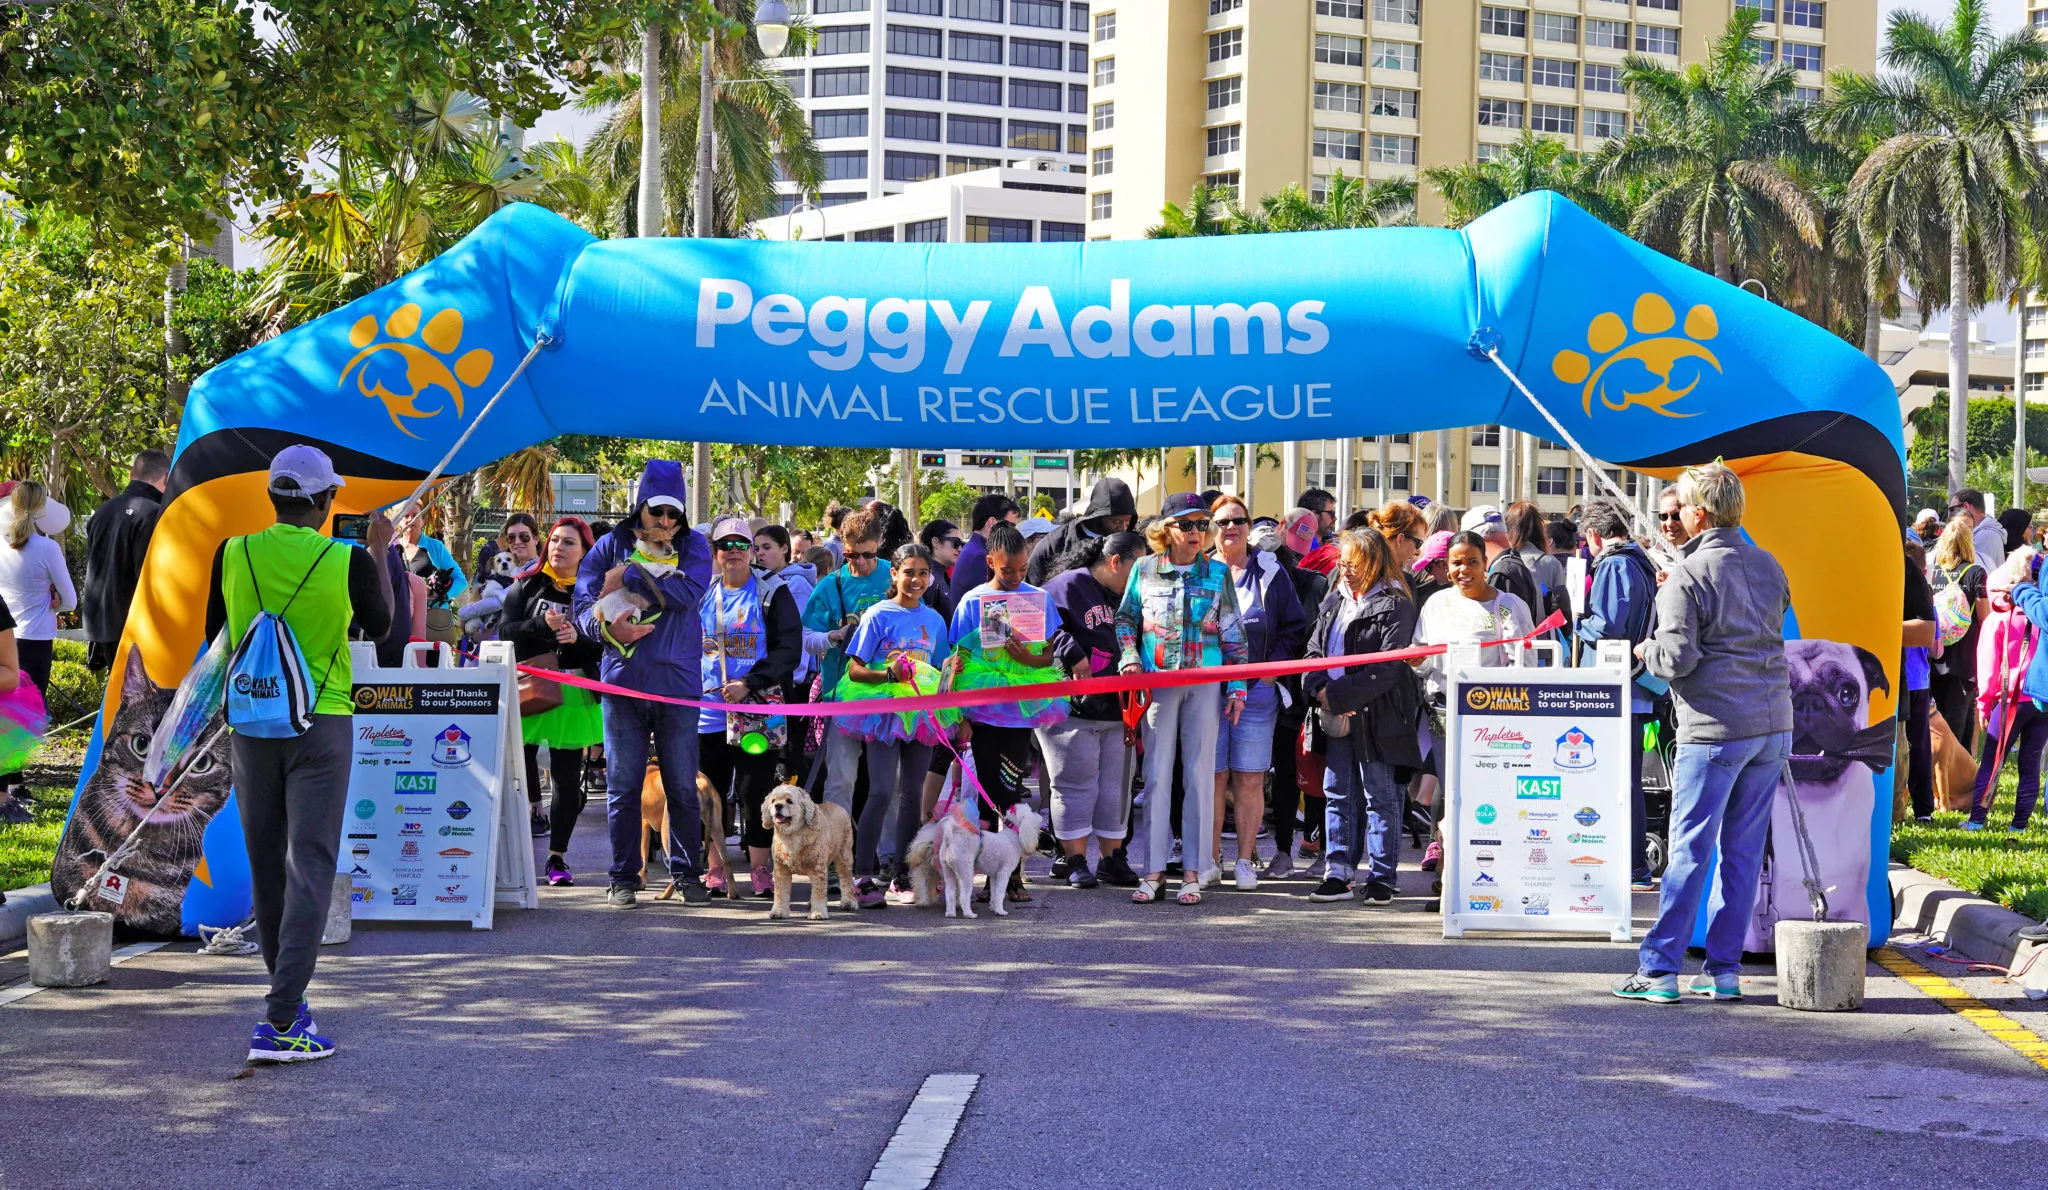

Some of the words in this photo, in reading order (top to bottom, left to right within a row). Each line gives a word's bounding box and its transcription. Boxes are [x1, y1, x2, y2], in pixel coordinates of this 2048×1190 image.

[695, 277, 992, 375] Peggy
[998, 278, 1330, 359] Adams
[699, 378, 902, 422] ANIMAL
[919, 386, 1111, 424] RESCUE
[1131, 382, 1332, 423] LEAGUE
[376, 686, 414, 700] WALK
[421, 689, 454, 698] Special
[456, 689, 488, 697] Thanks
[1490, 686, 1529, 700] WALK
[1538, 690, 1573, 699] Special
[1574, 690, 1610, 700] Thanks
[376, 701, 414, 710] ANIMALS
[421, 699, 431, 707] to
[450, 699, 492, 708] Sponsors
[1490, 702, 1531, 711] ANIMALS
[1538, 700, 1549, 708] to
[1569, 701, 1615, 710] Sponsors
[359, 724, 405, 744] Napleton
[1474, 726, 1524, 747] Napleton
[358, 758, 379, 767] Jeep
[1475, 760, 1498, 769] Jeep
[395, 776, 436, 790] KAST
[1517, 780, 1560, 795] KAST
[404, 806, 432, 814] HomeAgain
[398, 884, 419, 899] 25
[1469, 901, 1491, 911] 107.9
